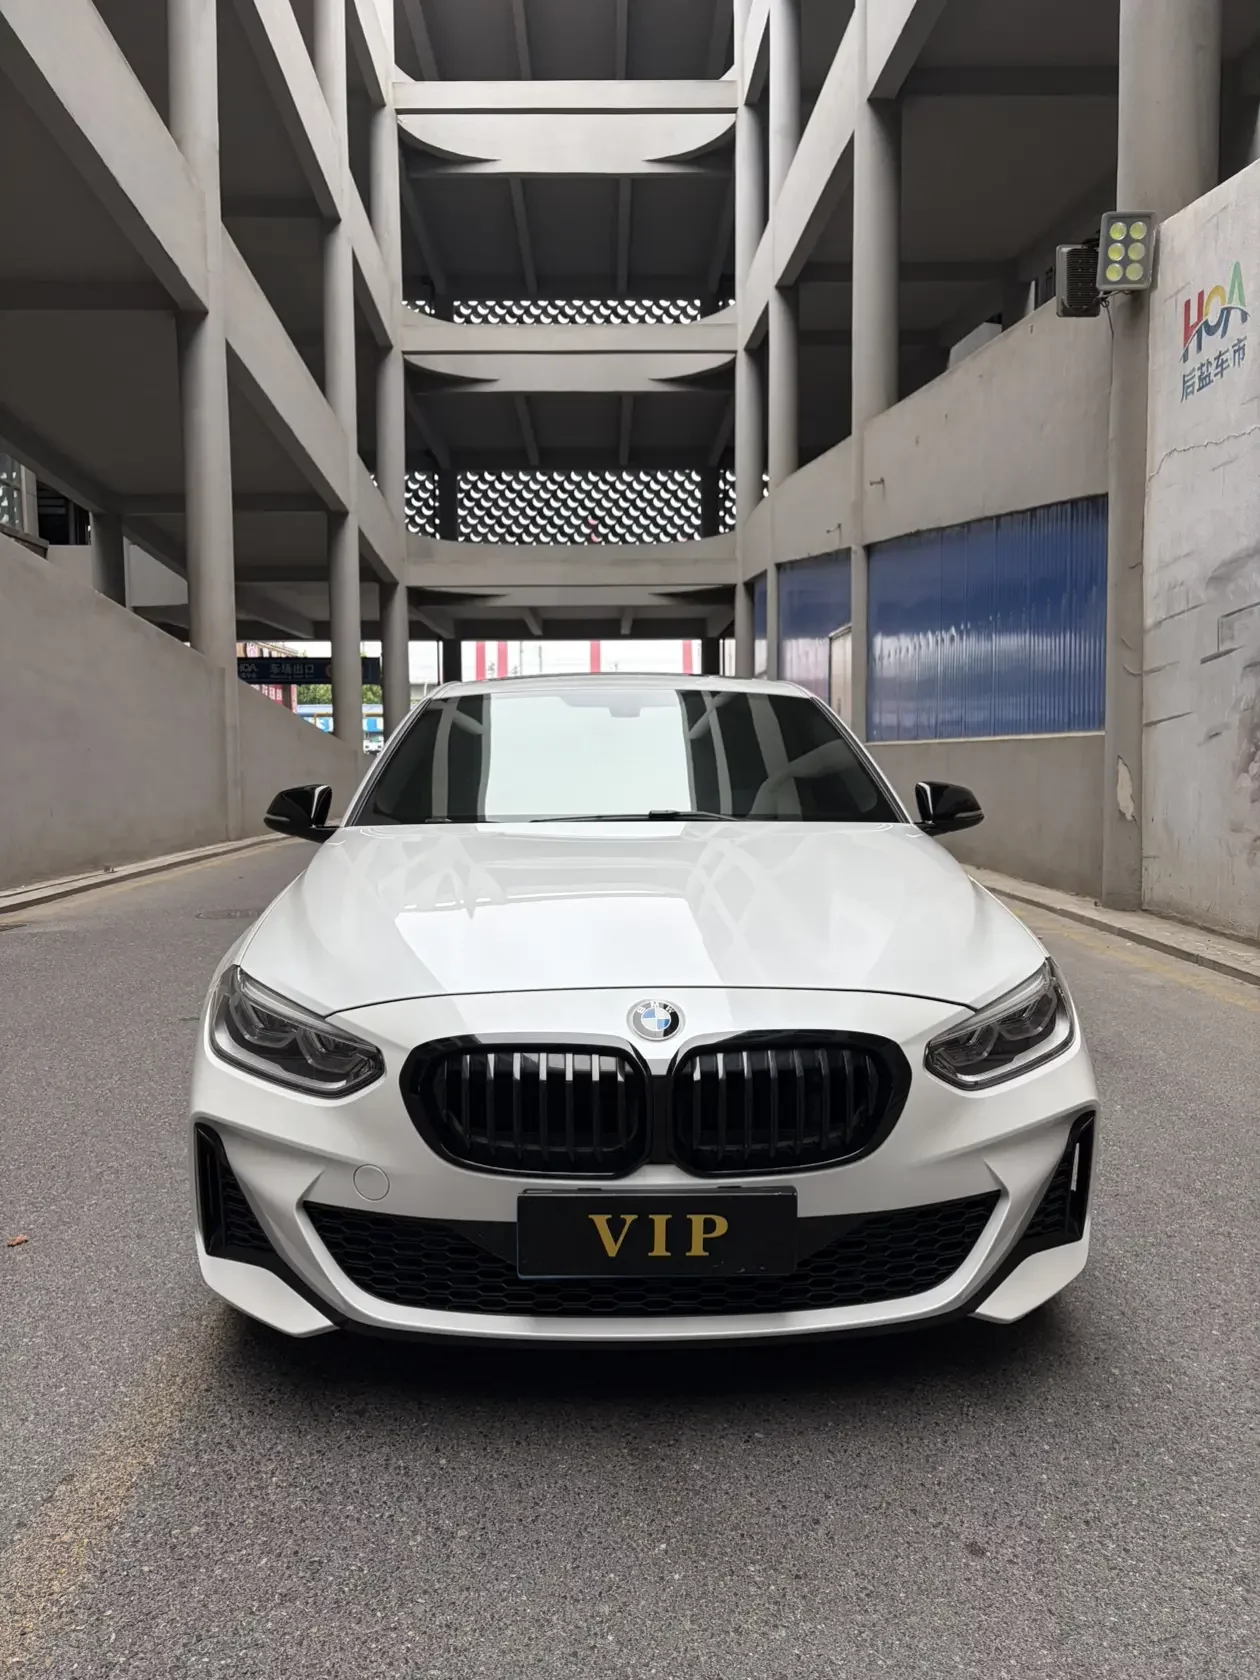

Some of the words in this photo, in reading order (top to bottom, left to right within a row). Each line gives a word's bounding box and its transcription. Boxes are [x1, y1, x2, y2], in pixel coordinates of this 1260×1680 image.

[1180, 261, 1250, 363] HOA
[1181, 336, 1247, 403] 后盐车市
[637, 1001, 675, 1014] BMW
[588, 1214, 728, 1257] VIP
